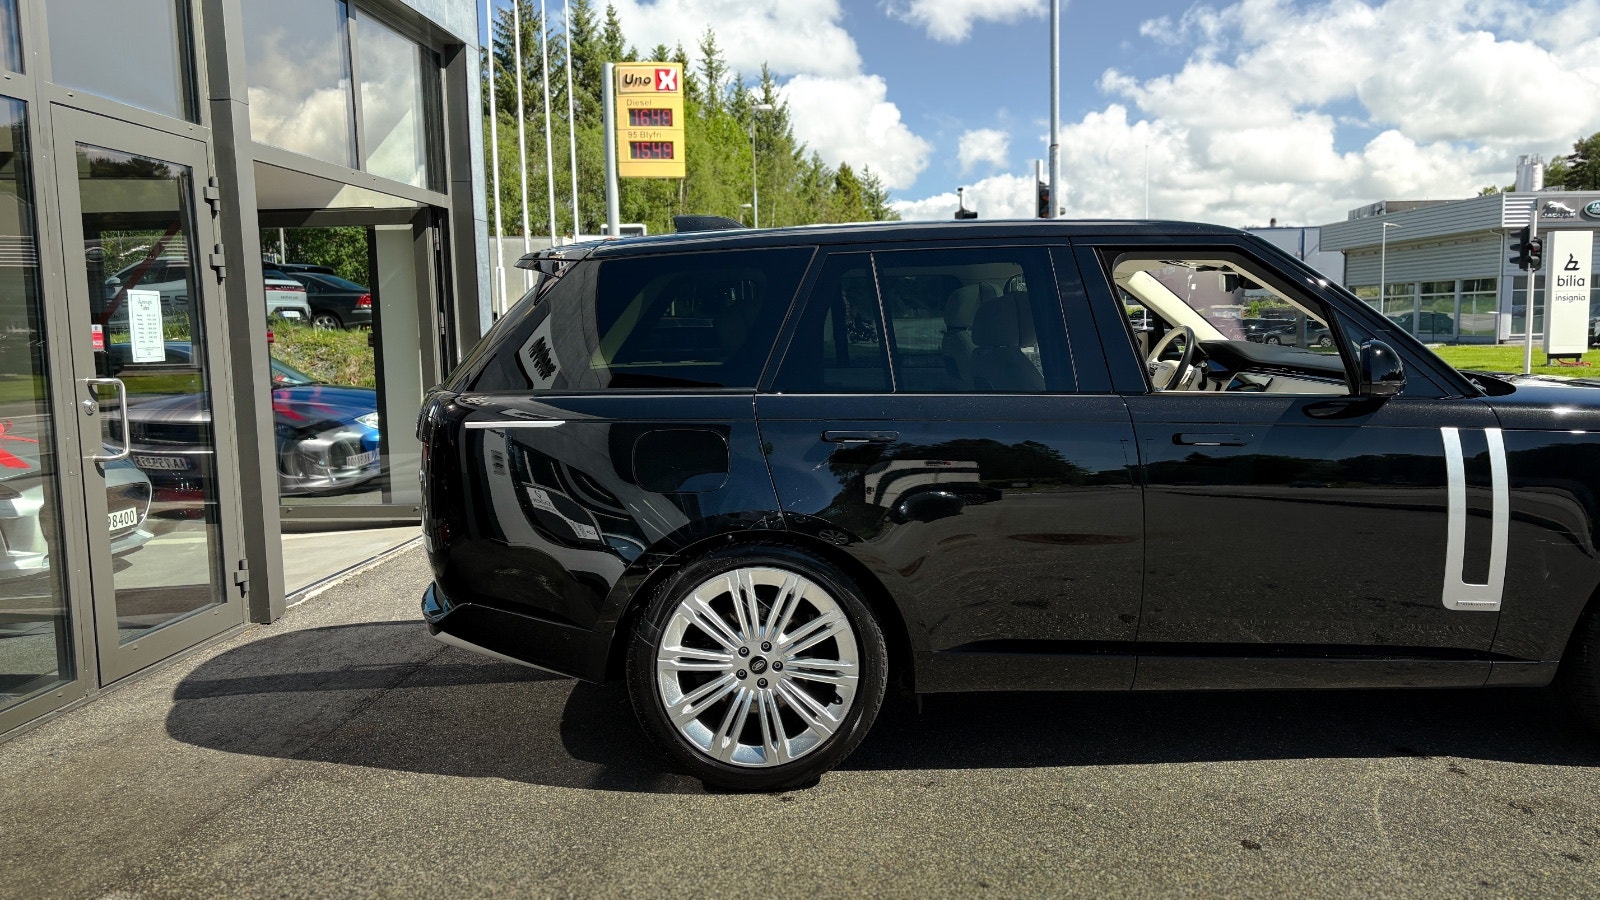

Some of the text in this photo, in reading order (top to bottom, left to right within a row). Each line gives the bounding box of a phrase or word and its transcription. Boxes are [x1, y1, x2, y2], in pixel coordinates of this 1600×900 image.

[624, 73, 652, 85] Uno
[626, 99, 652, 107] Diesel
[634, 109, 671, 126] 1649
[627, 131, 662, 140] 95 Blyfri
[635, 142, 673, 159] 1549
[1557, 275, 1585, 287] bilia
[1555, 294, 1585, 303] insignia
